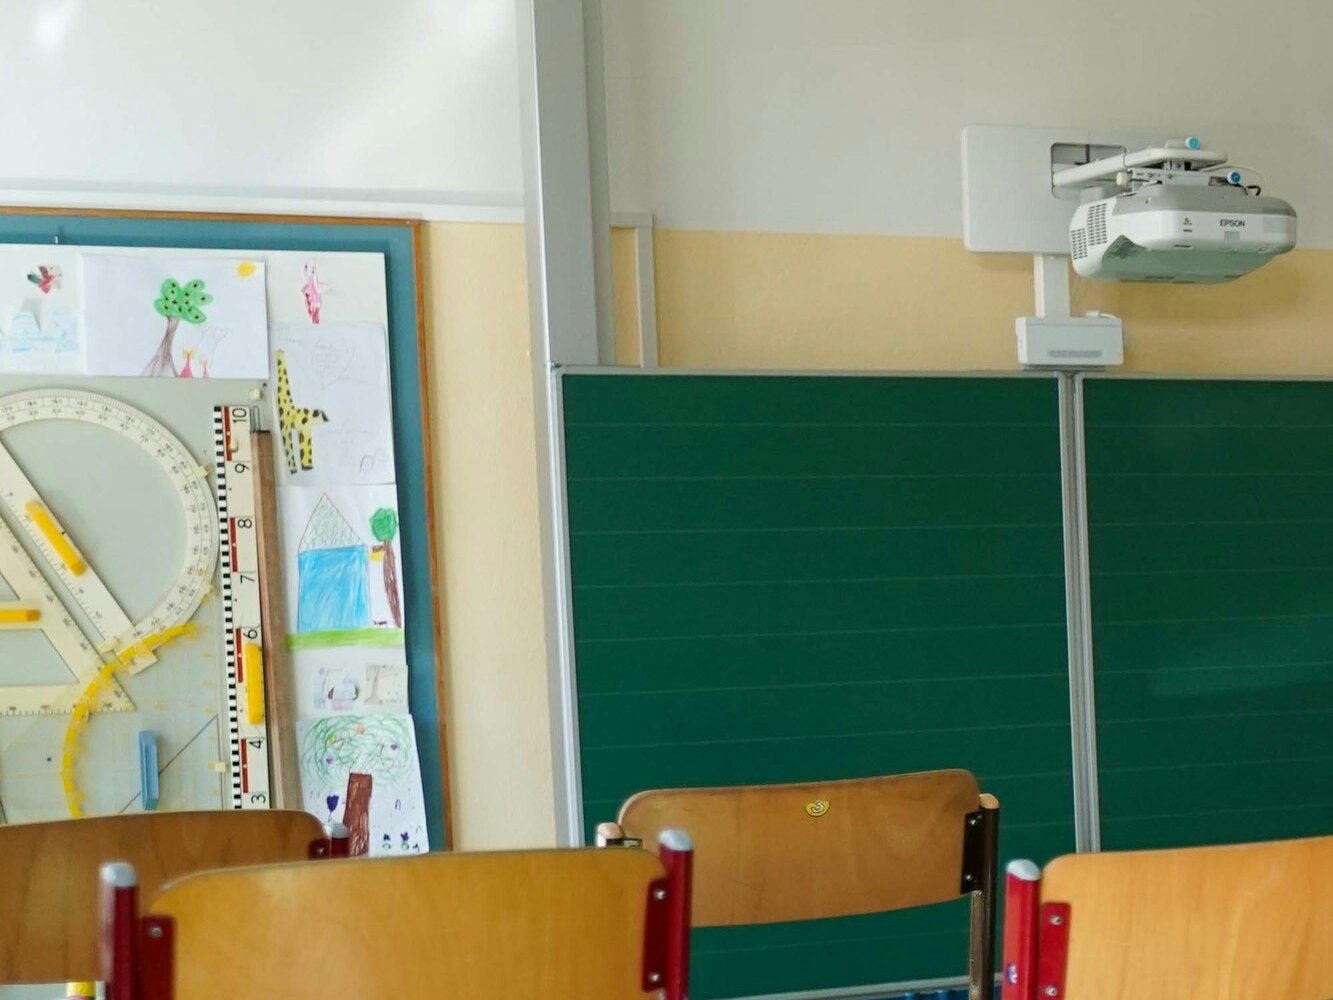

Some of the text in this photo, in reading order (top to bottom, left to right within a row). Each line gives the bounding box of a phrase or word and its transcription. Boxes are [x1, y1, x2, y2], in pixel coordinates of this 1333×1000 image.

[1219, 218, 1246, 228] EPSON
[232, 406, 248, 424] 10
[237, 518, 253, 530] 8
[240, 573, 256, 585] 7
[248, 739, 263, 750] 4
[250, 792, 266, 805] 3
